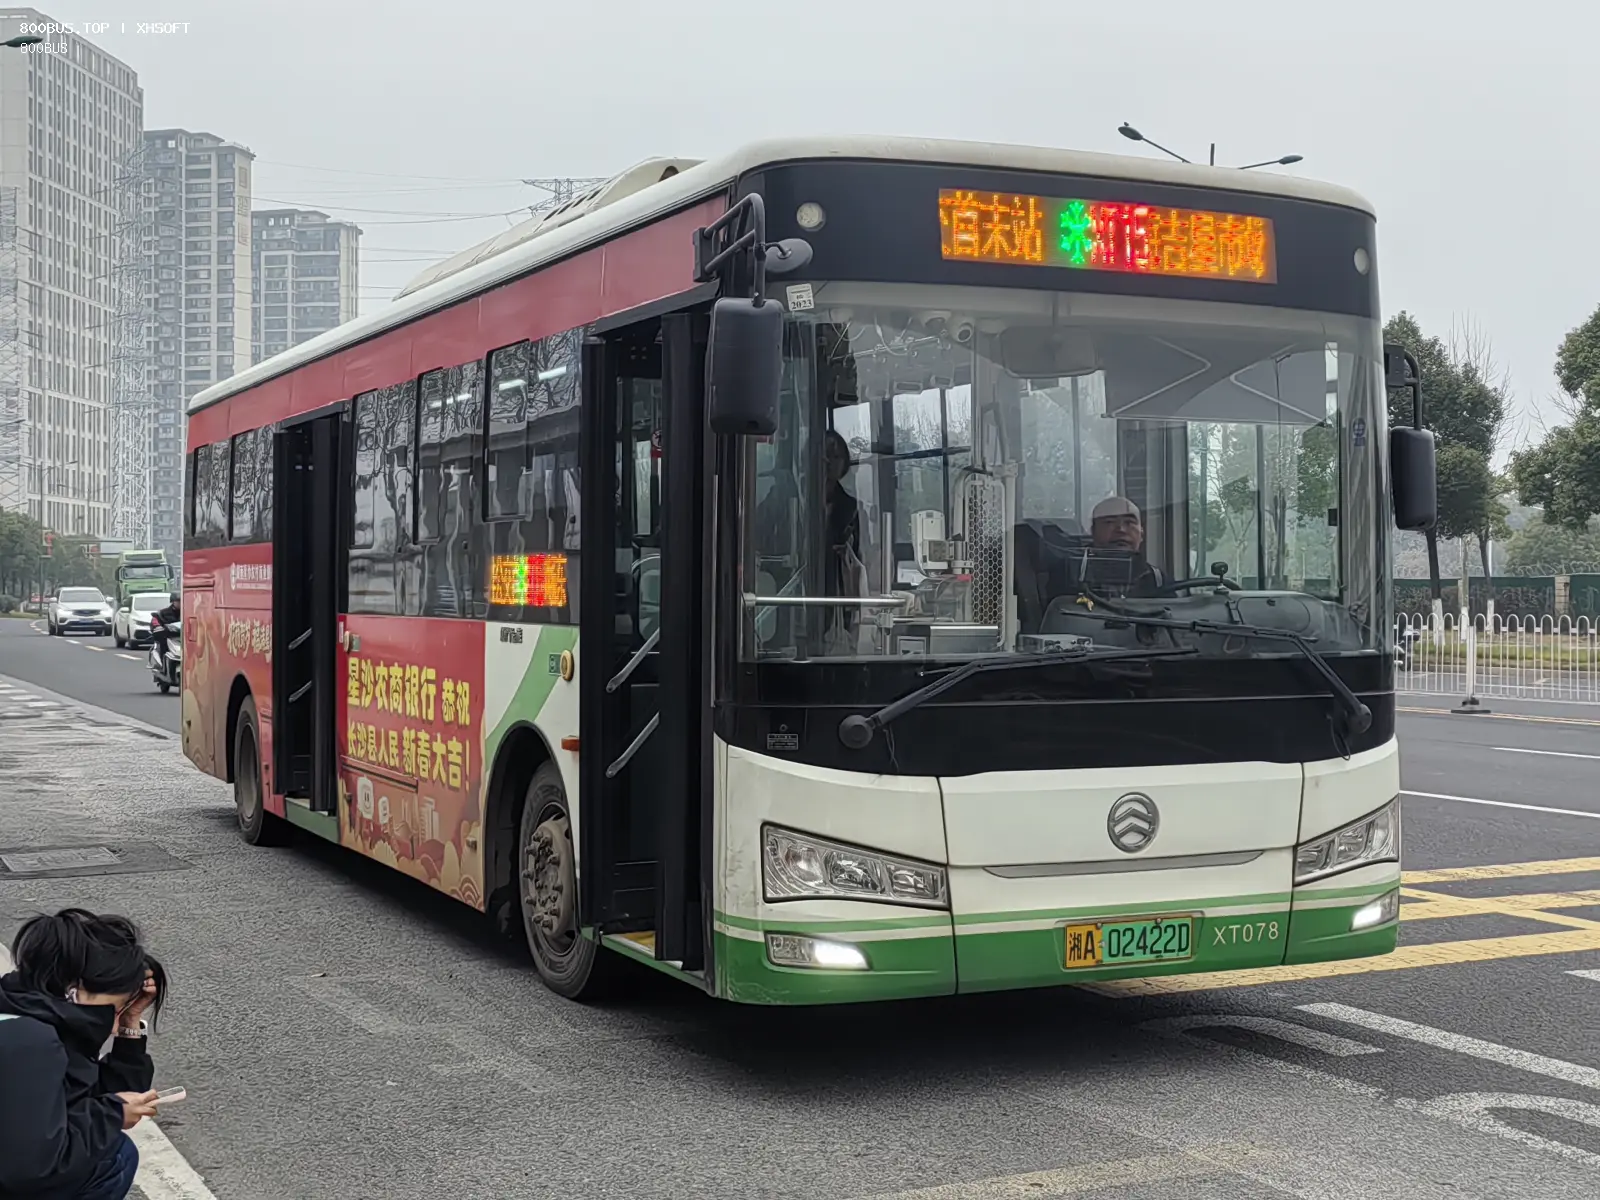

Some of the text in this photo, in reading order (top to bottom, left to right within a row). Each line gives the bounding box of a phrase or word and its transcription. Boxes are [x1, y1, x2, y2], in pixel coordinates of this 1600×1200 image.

[939, 189, 1043, 262] 首末站
[791, 299, 812, 309] 2023
[347, 656, 471, 726] 星沙农商银行 恭祝
[347, 718, 400, 768] 长沙县人民
[1068, 922, 1190, 962] 湘A 02422D
[1212, 920, 1279, 947] XT078
